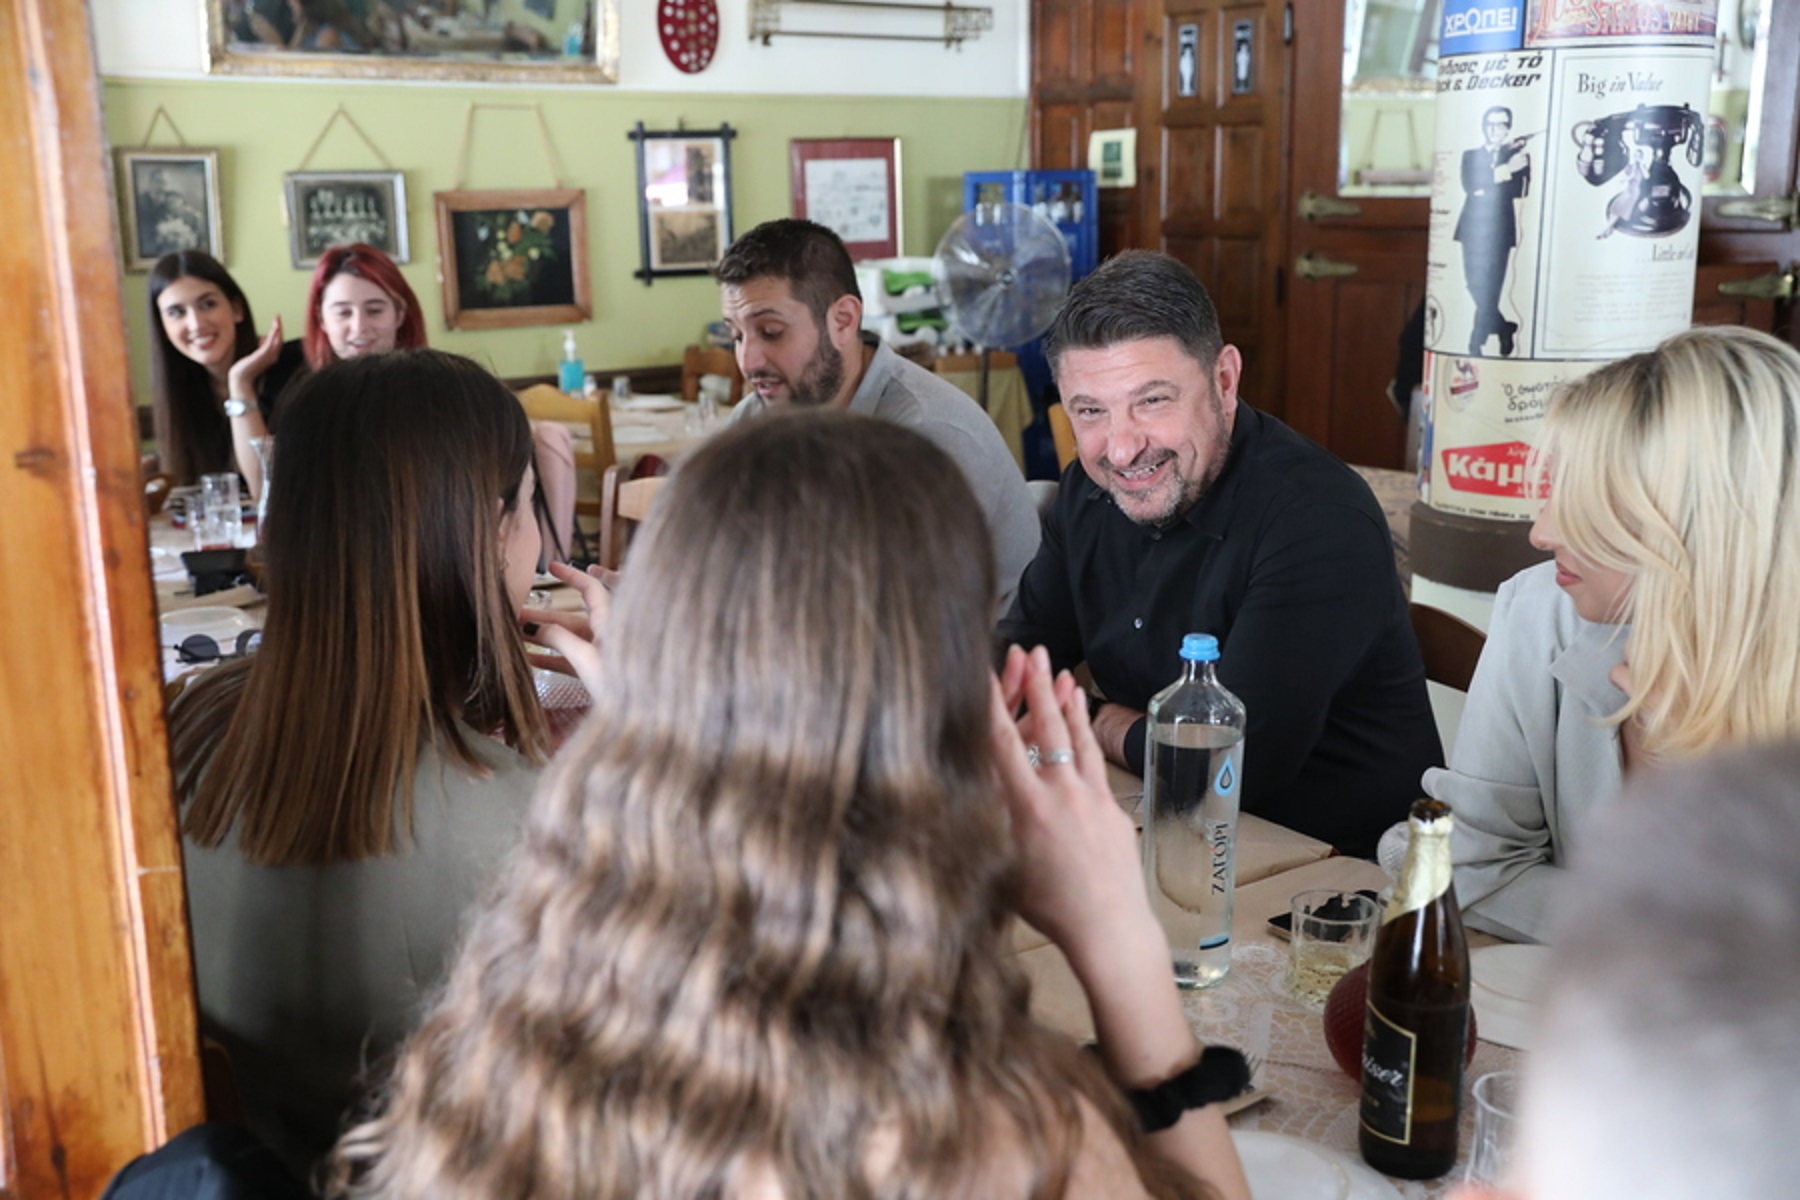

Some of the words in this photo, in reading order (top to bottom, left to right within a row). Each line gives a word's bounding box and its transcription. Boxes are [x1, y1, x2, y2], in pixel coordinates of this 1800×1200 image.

[1466, 73, 1542, 91] Decker
[1577, 72, 1606, 99] Big
[1609, 76, 1625, 92] in
[1627, 71, 1664, 92] Value
[1448, 453, 1528, 488] Κάμ
